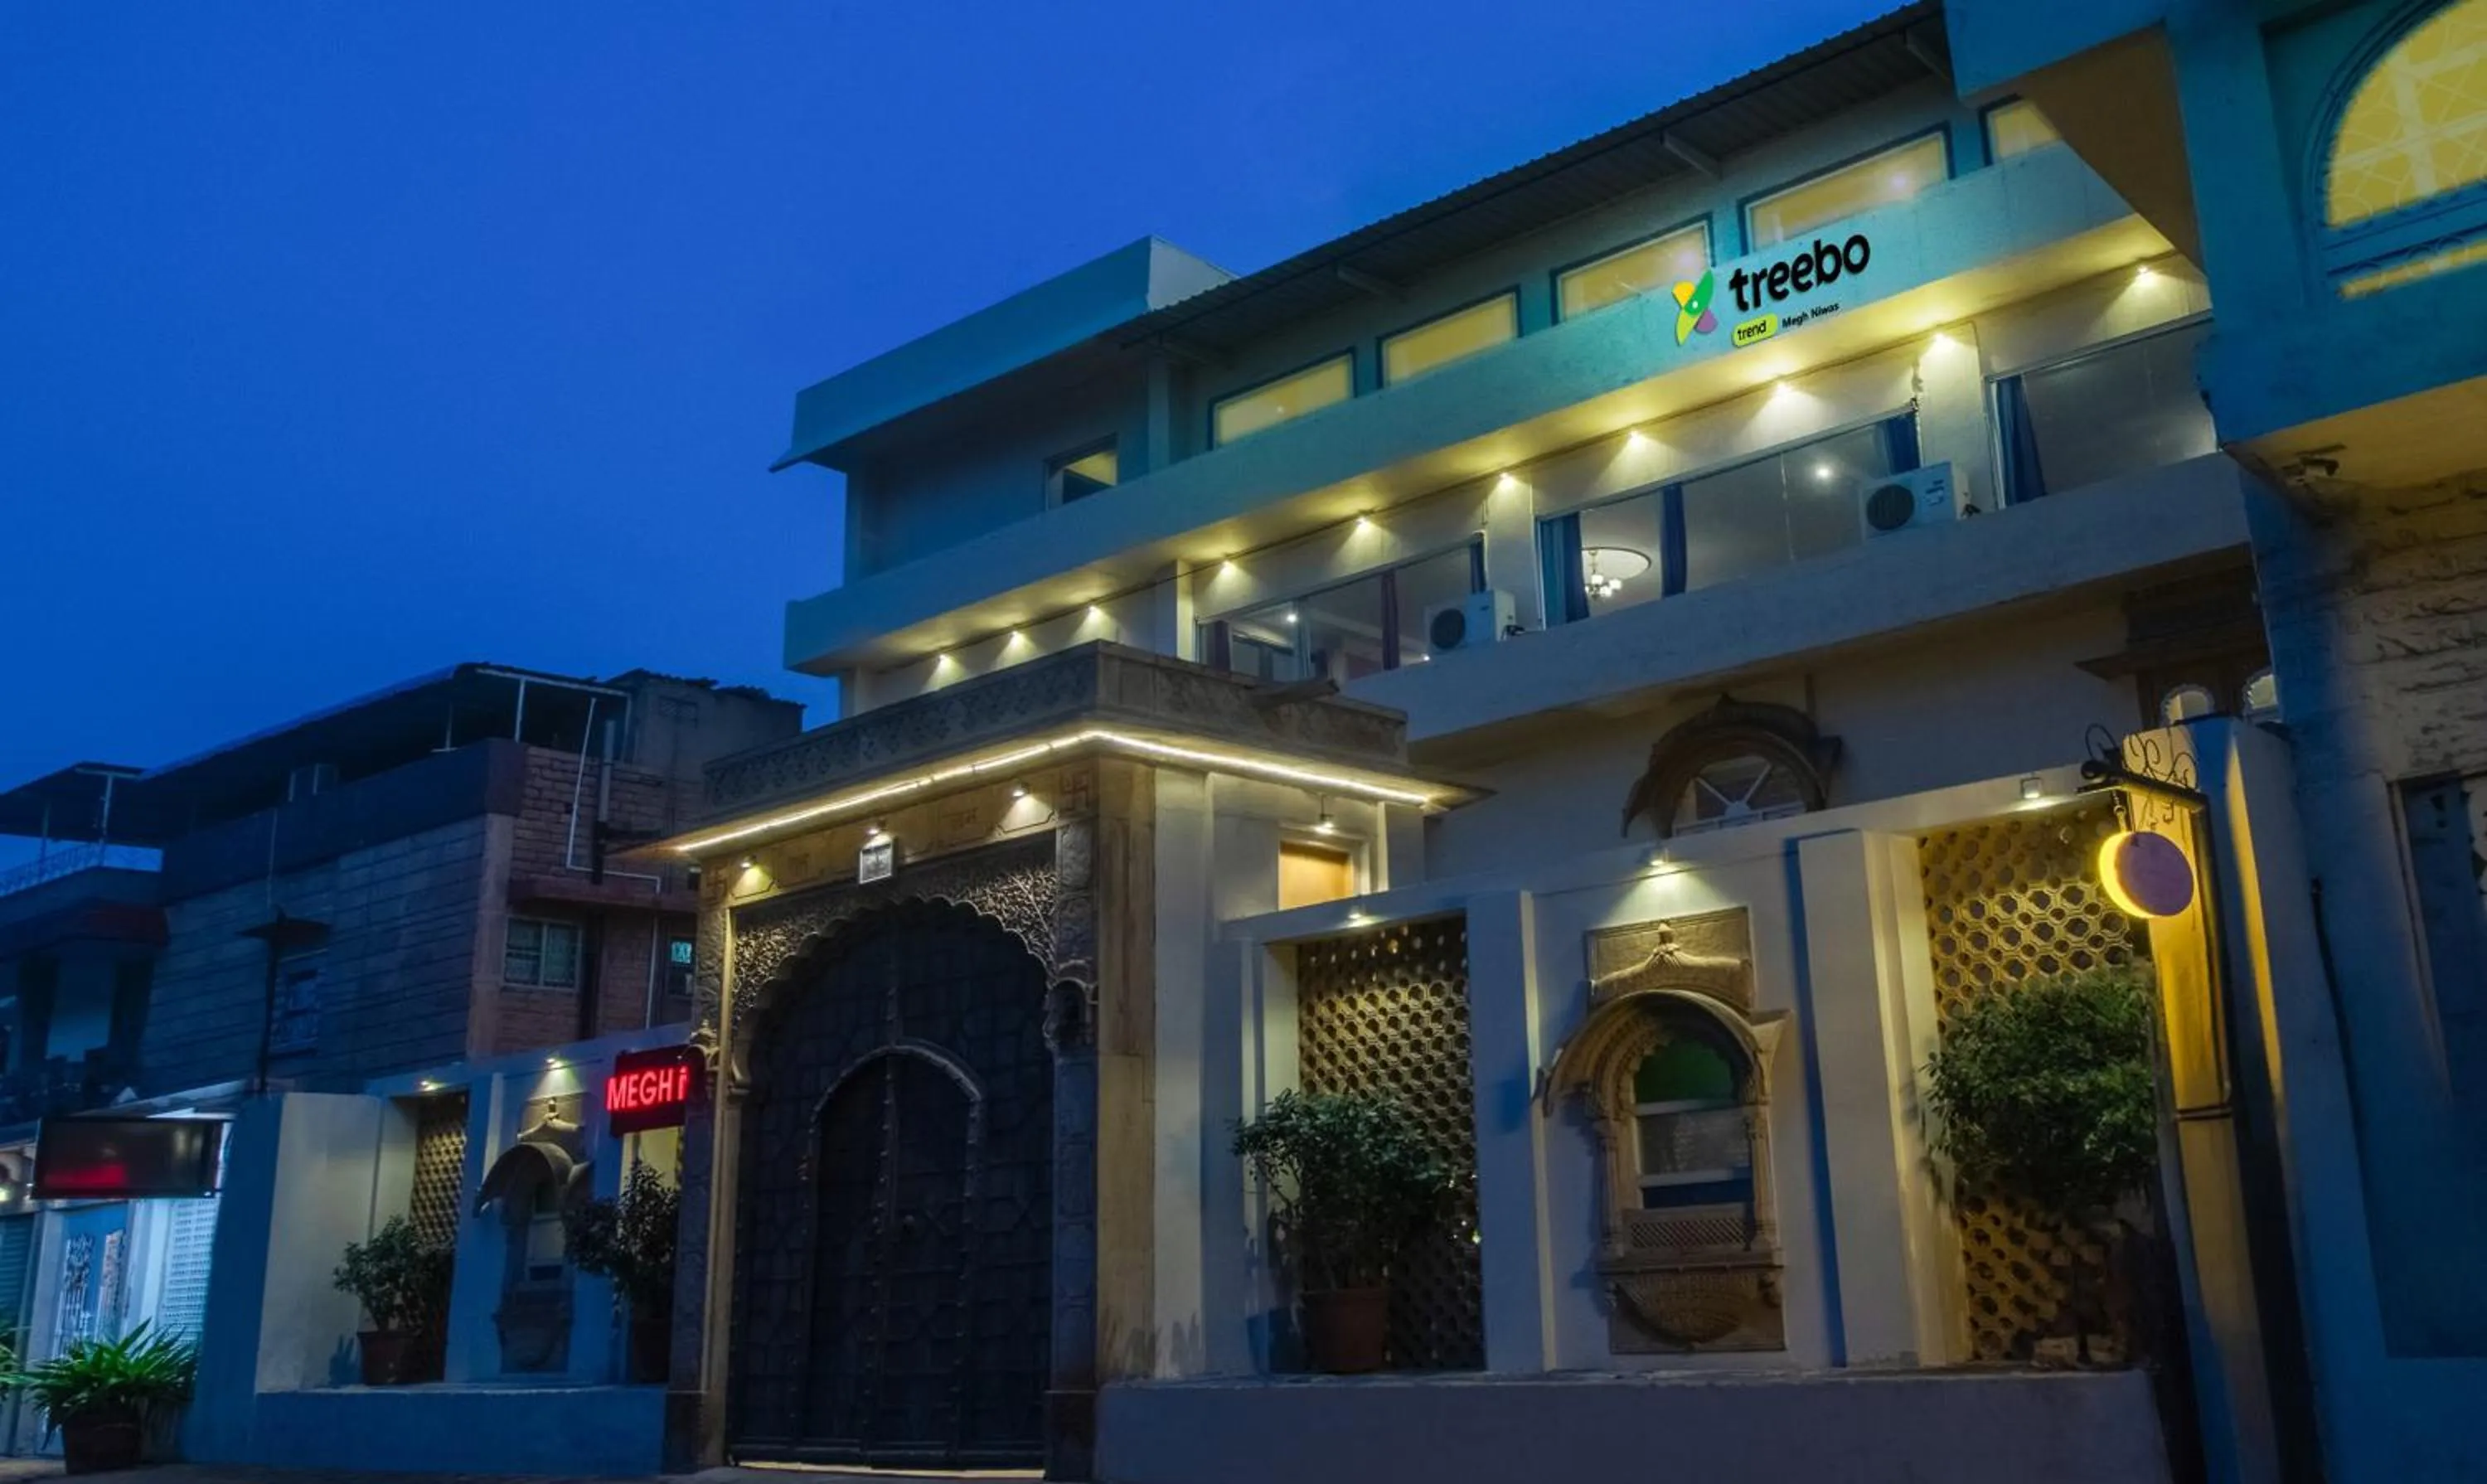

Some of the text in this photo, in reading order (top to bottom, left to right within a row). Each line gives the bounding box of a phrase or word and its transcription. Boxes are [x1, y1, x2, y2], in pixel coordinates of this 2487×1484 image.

[1728, 234, 1871, 313] treebo
[1737, 319, 1767, 341] trend
[1782, 312, 1809, 328] Megh
